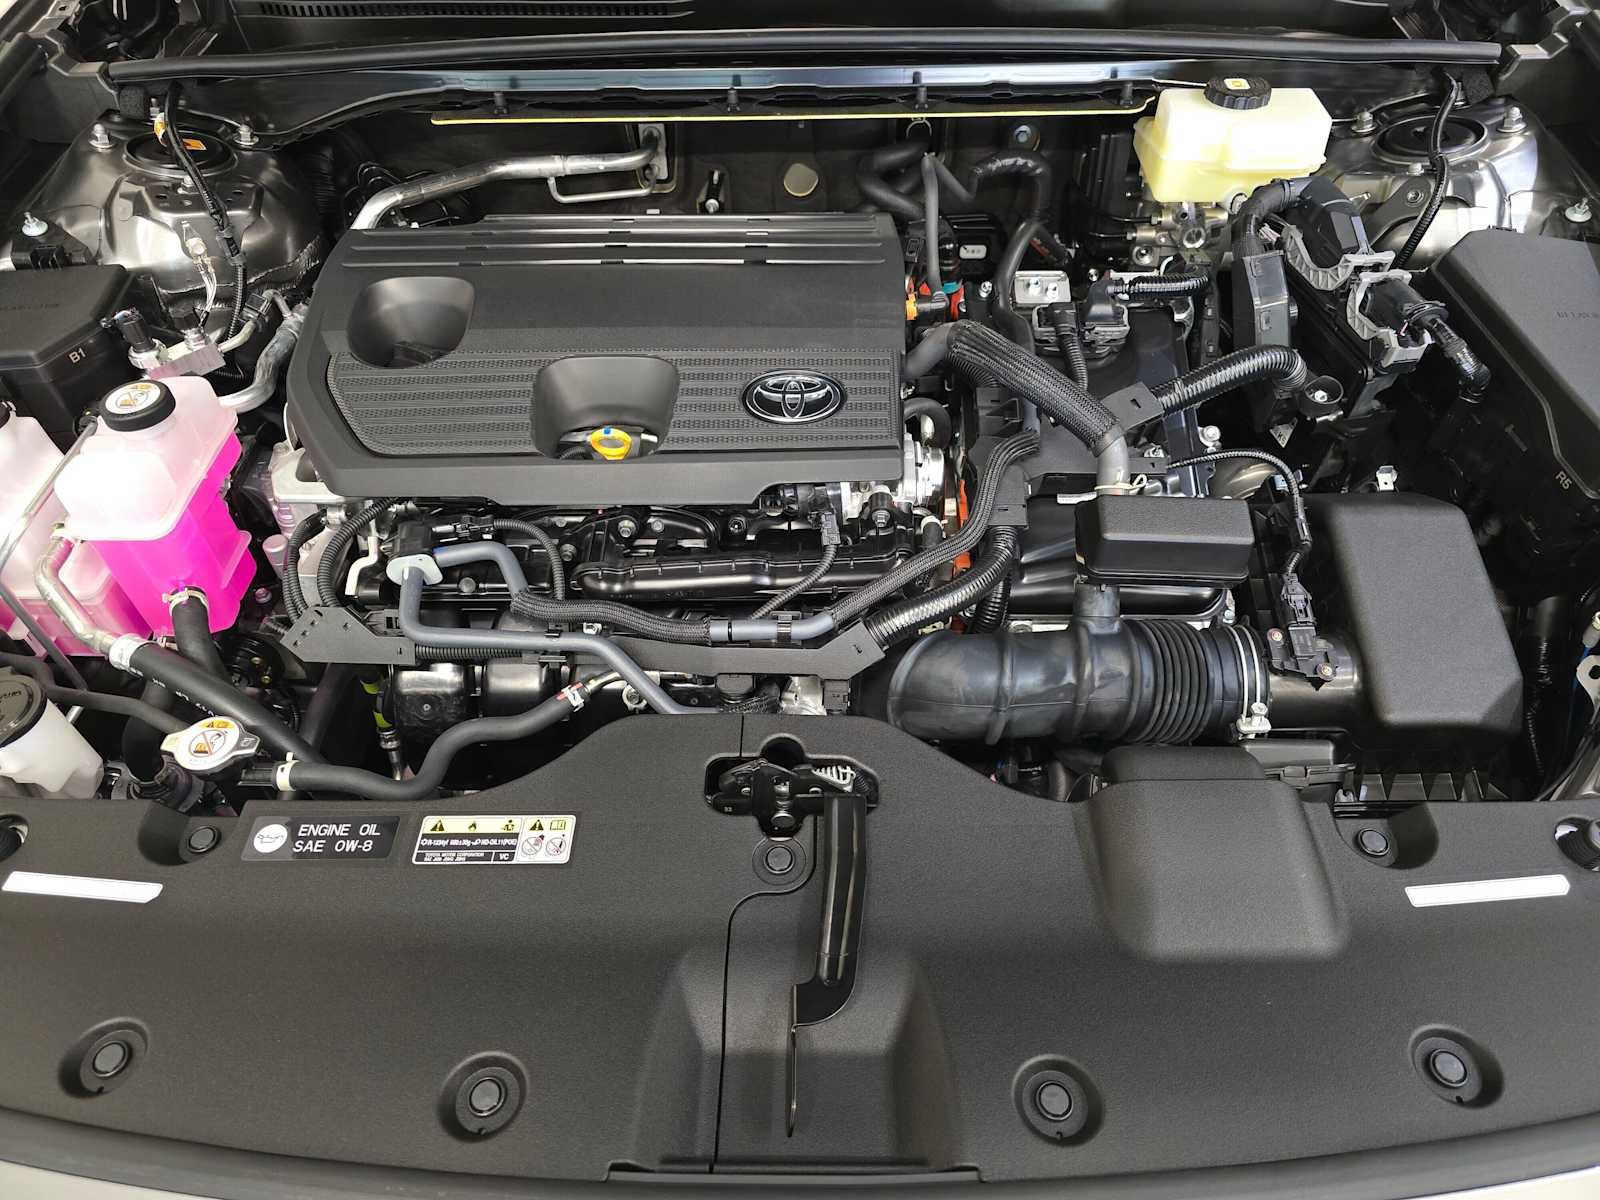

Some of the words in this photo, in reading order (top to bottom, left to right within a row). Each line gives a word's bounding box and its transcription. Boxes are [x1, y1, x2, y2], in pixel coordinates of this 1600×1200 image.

[69, 347, 86, 363] B1
[298, 823, 351, 837] ENGINE
[359, 823, 381, 837] OIL
[292, 840, 326, 853] SAE
[335, 840, 373, 853] 0W-8
